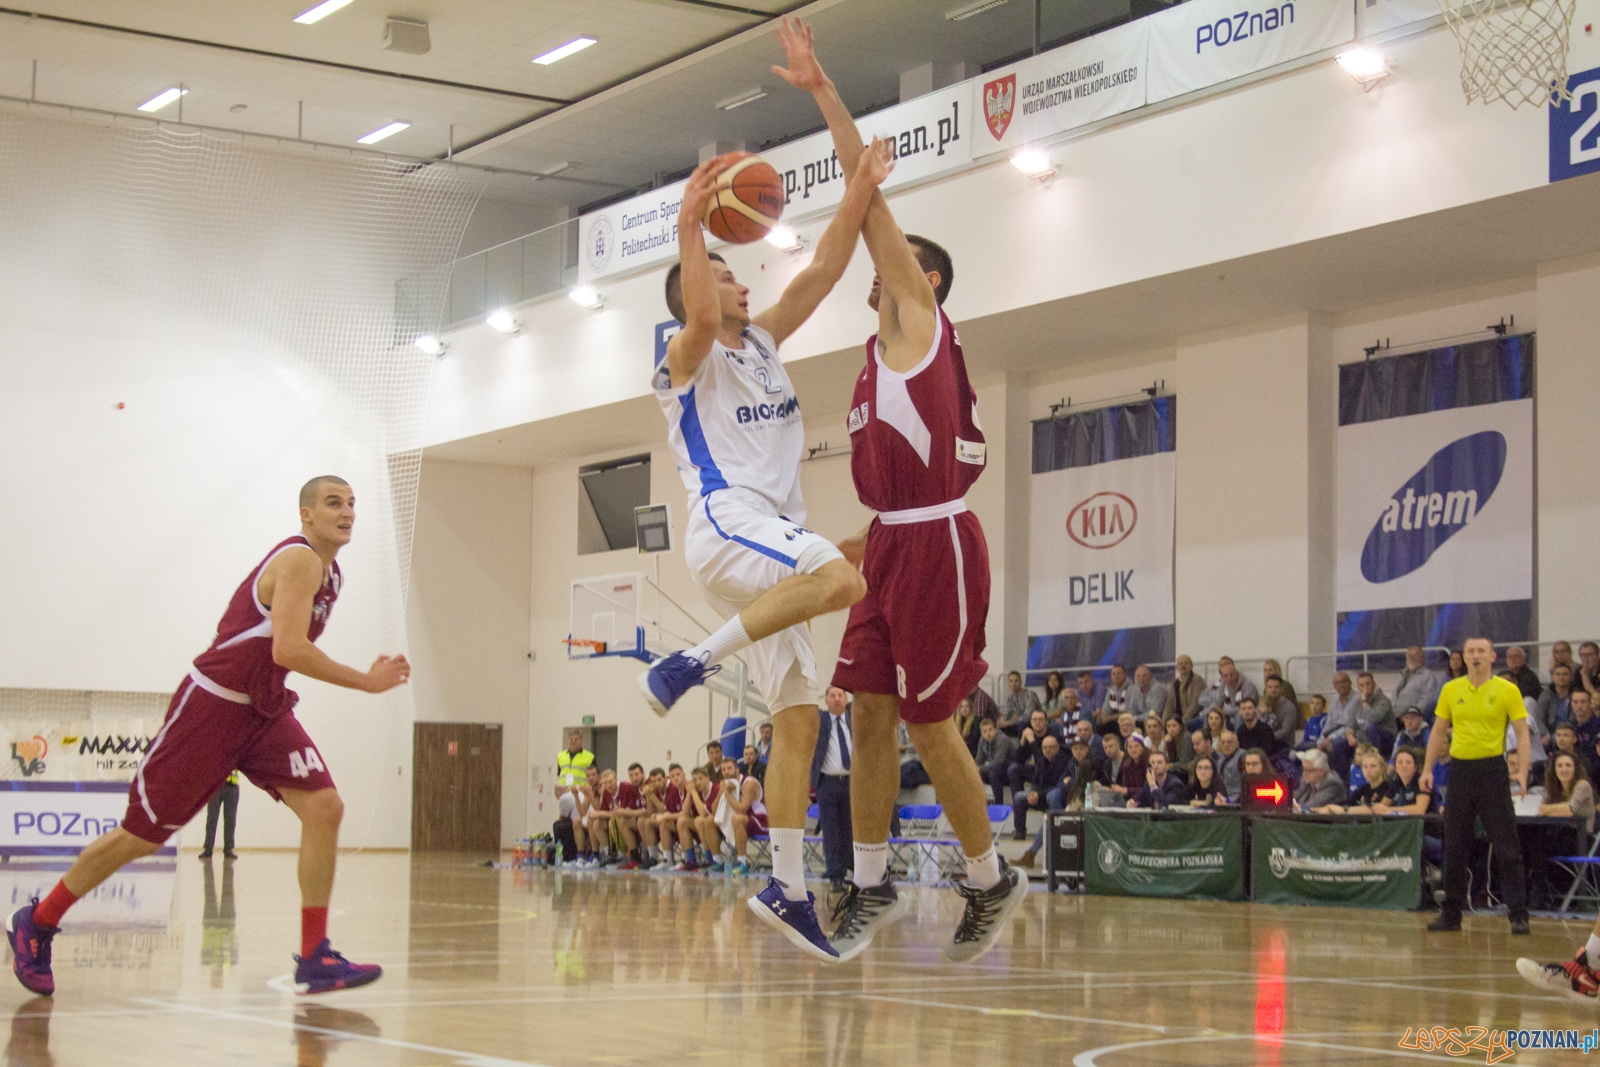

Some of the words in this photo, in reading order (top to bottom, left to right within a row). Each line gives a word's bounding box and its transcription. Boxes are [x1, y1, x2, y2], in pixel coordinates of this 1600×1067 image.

[1022, 81, 1045, 99] URZĄD
[1046, 61, 1104, 91] MARSZAŁKOWSKI
[1022, 89, 1072, 116] WOJEWÓDZTWA
[1074, 66, 1138, 99] WIELKOPOLSKIEGO
[1569, 79, 1600, 165] 2
[621, 209, 658, 231] Centrum
[621, 226, 670, 257] Politechniki
[754, 366, 782, 394] 2
[1082, 503, 1125, 538] KIA
[1382, 488, 1477, 533] atrem
[1069, 569, 1135, 606] DELIK
[97, 758, 115, 770] hit
[288, 747, 325, 778] 44
[14, 812, 124, 836] POZna
[1128, 855, 1180, 868] POLITECHNIKA
